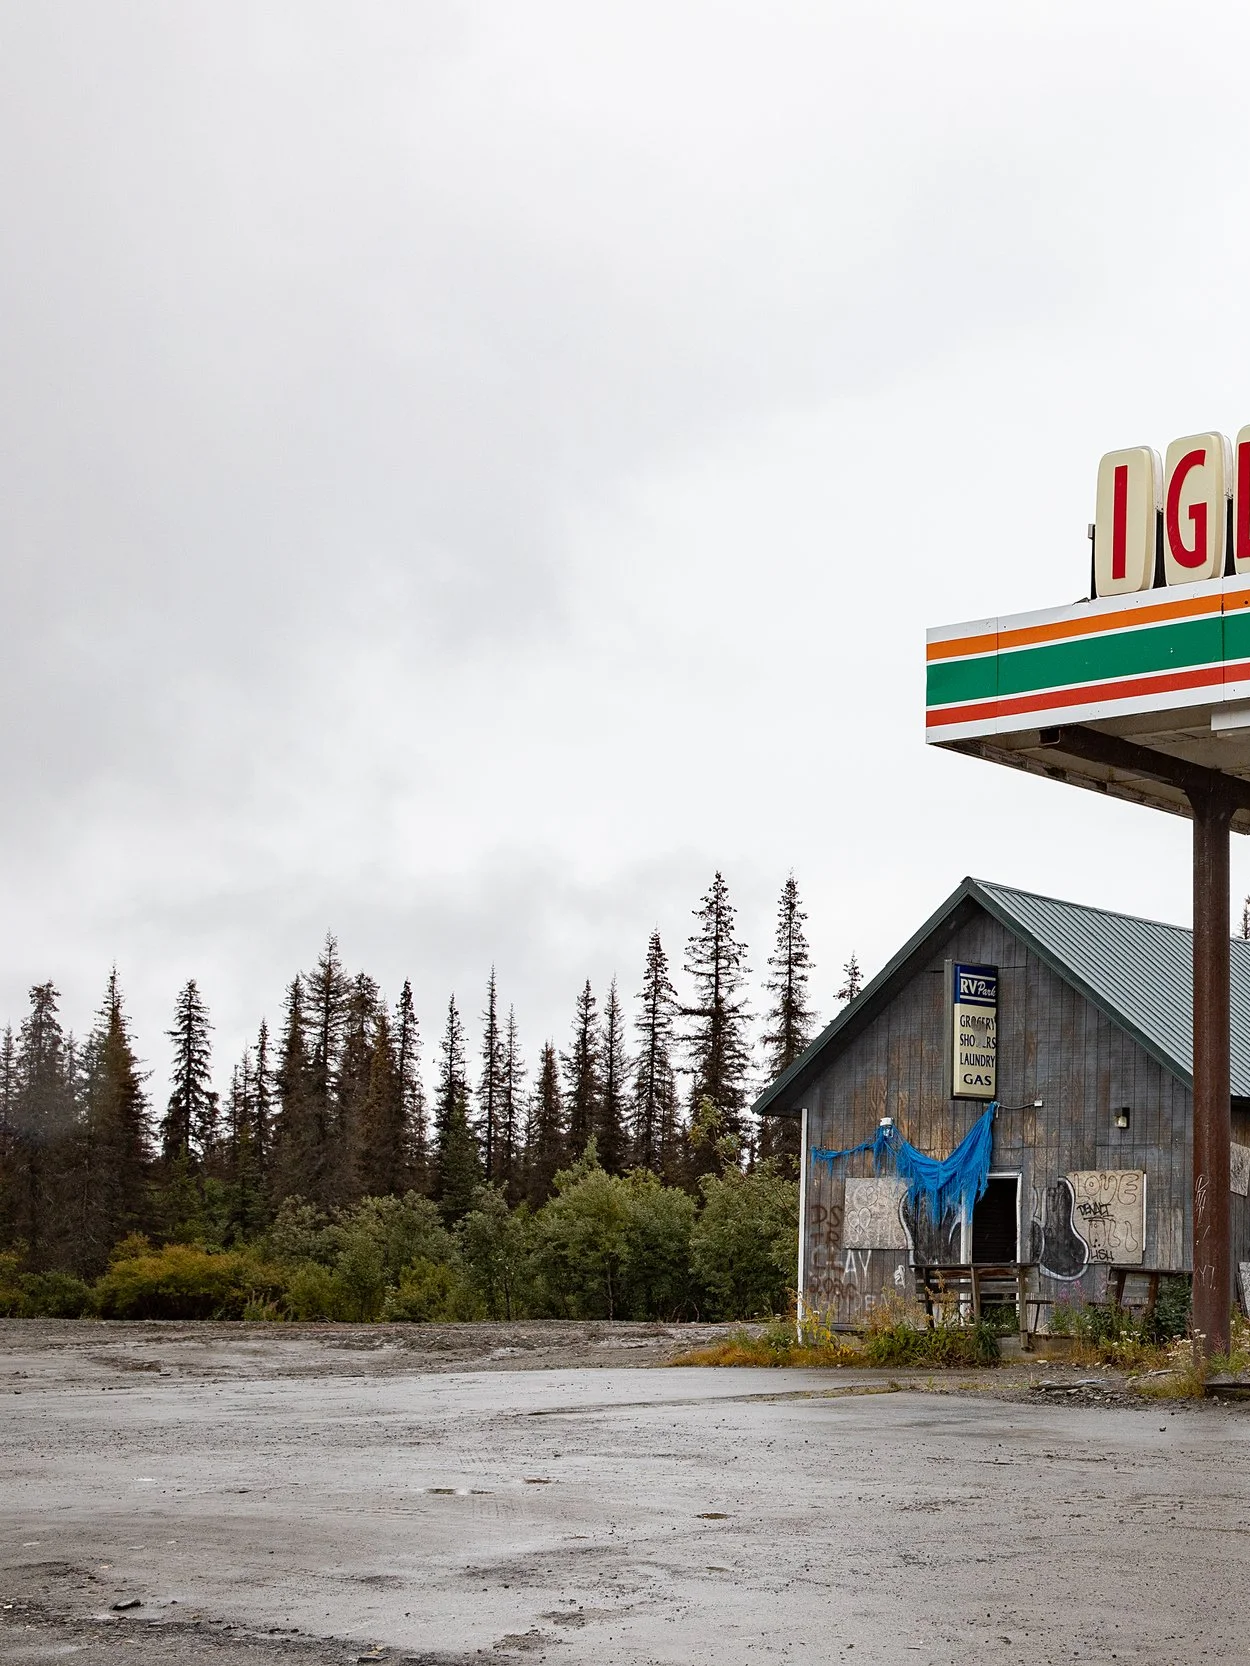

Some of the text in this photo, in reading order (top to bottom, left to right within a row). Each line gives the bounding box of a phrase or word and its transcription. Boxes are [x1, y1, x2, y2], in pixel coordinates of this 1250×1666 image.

[960, 978, 996, 997] RV Park
[960, 1033, 996, 1049] SHORS
[960, 1052, 995, 1067] LAUNDRY
[963, 1073, 992, 1086] GAS
[1073, 1172, 1140, 1206] LOVE
